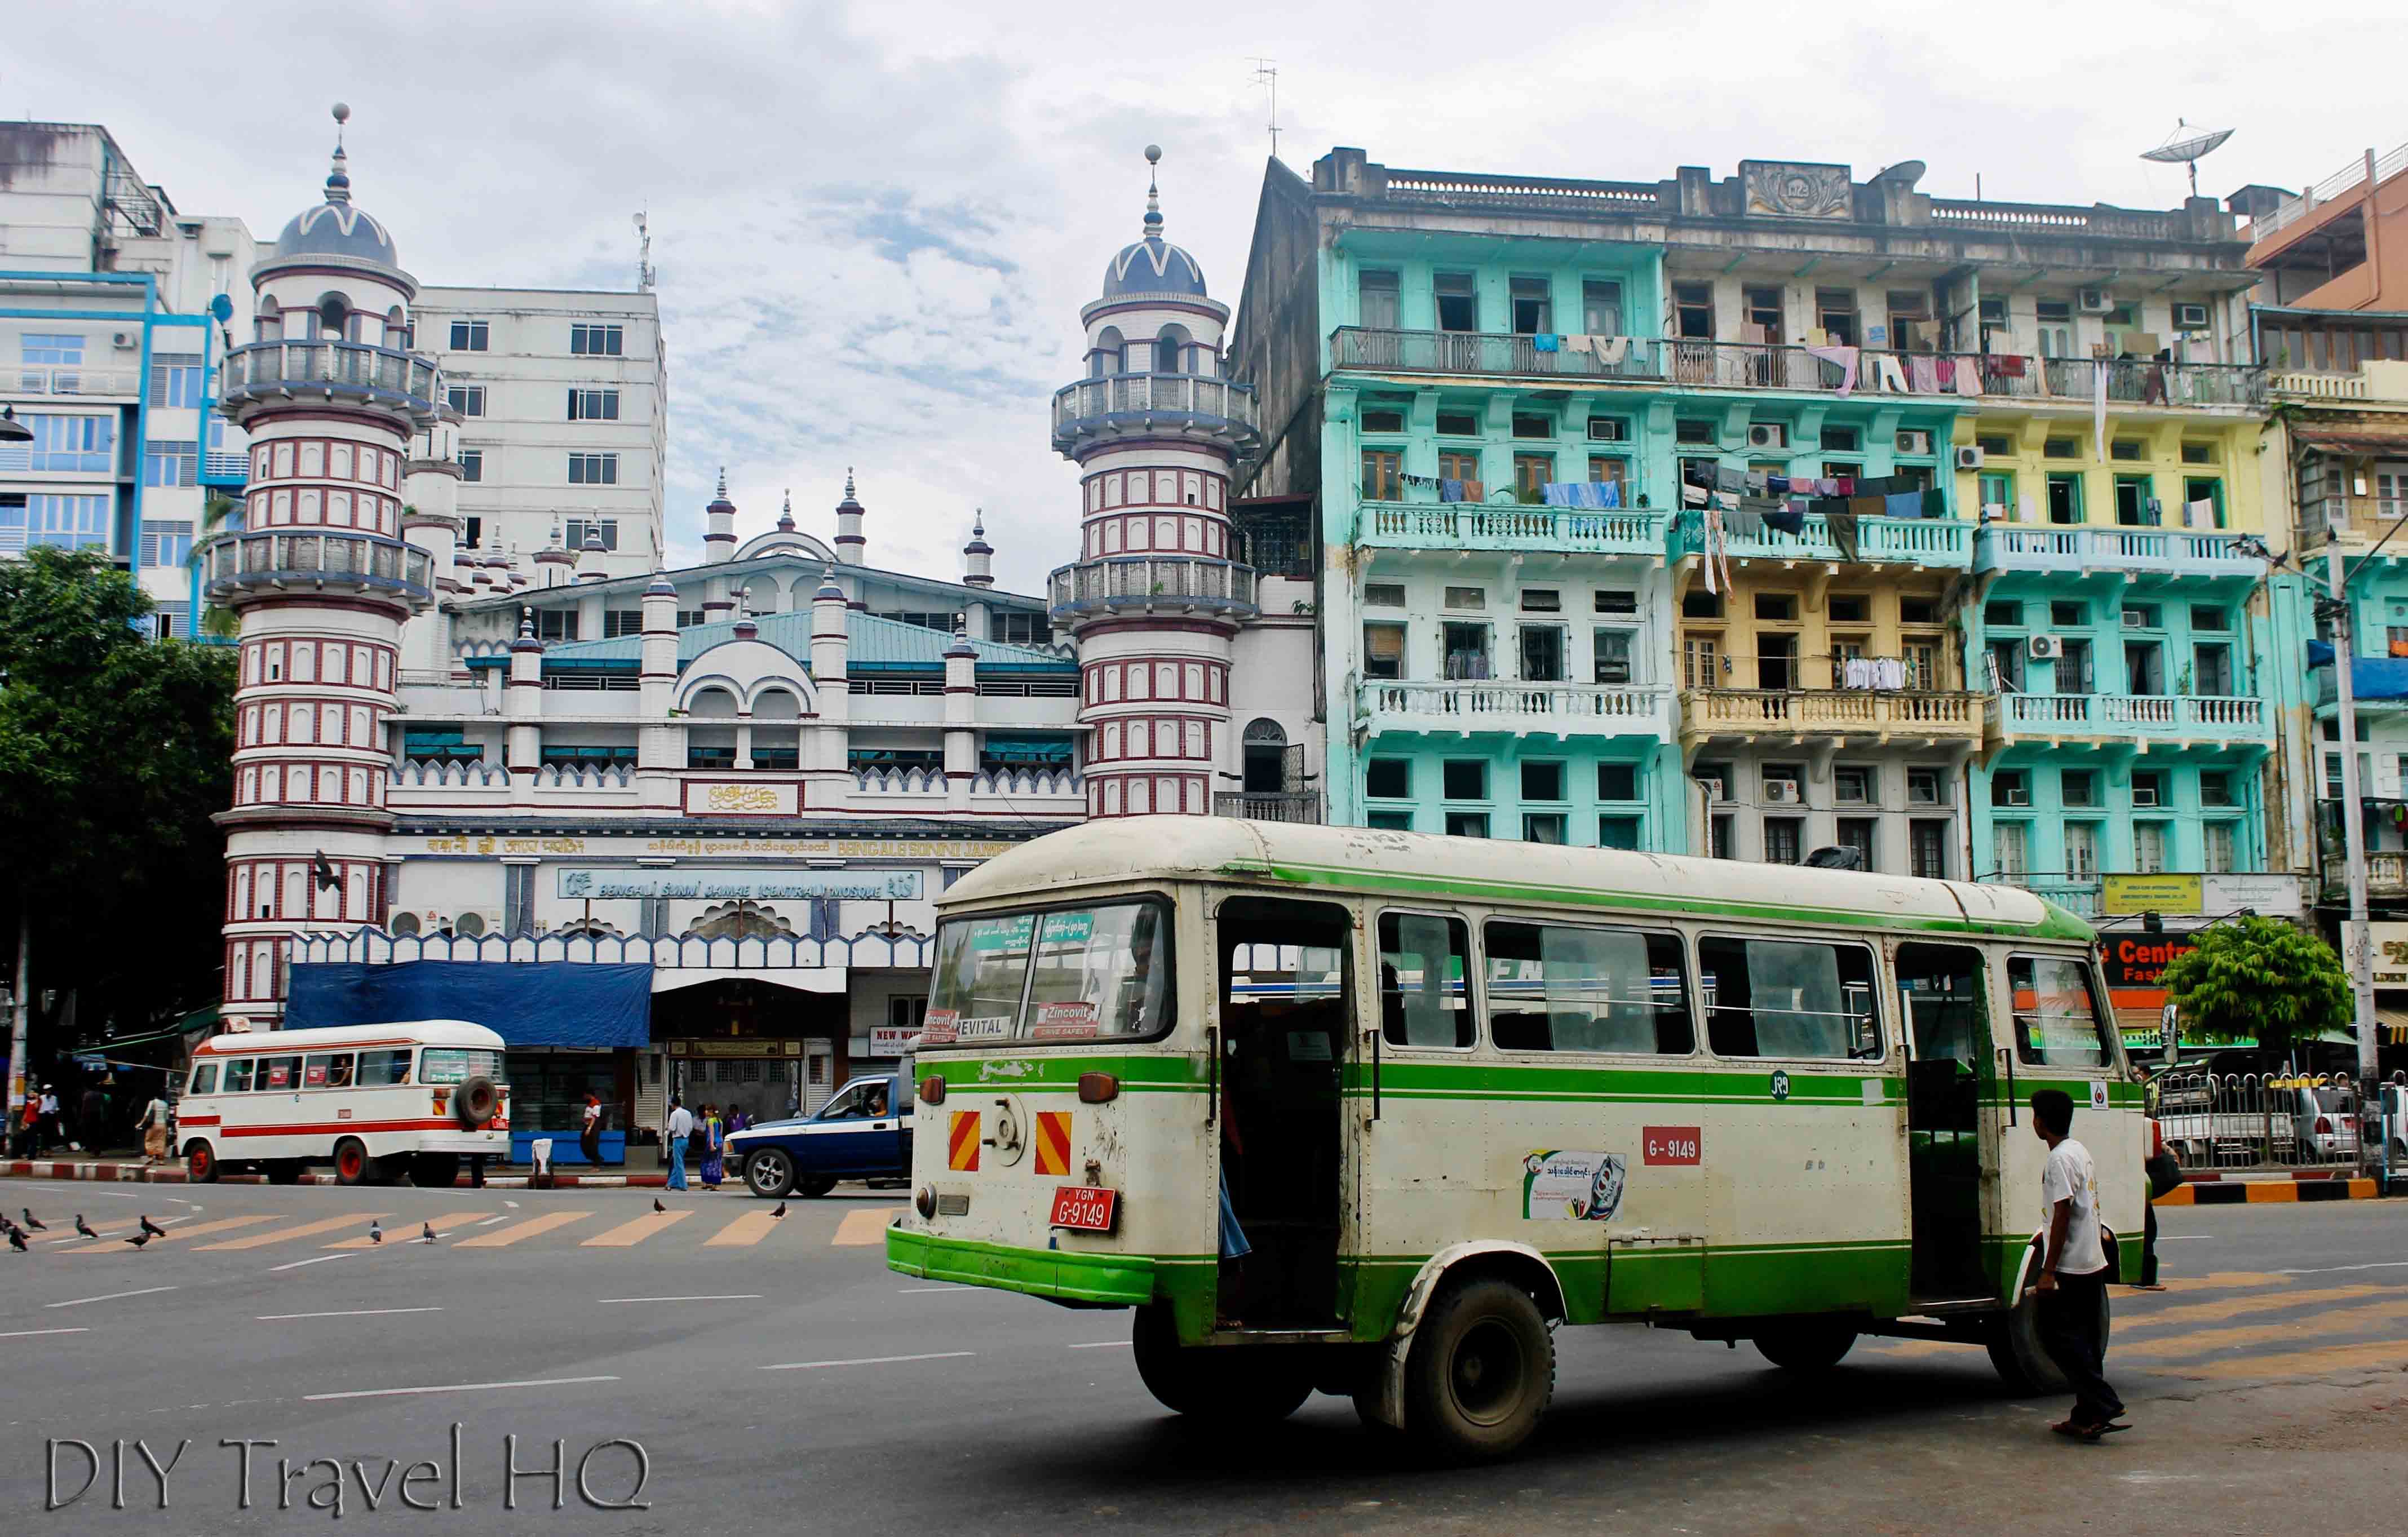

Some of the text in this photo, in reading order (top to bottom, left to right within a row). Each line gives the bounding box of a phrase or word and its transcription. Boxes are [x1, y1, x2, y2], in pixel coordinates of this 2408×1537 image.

[829, 884, 881, 899] MOSQUE
[2123, 967, 2164, 981] Fash
[1047, 1006, 1088, 1020] Zincovit
[877, 1030, 896, 1040] NEW
[1075, 1189, 1095, 1201] YGN
[1059, 1201, 1104, 1225] G-9149
